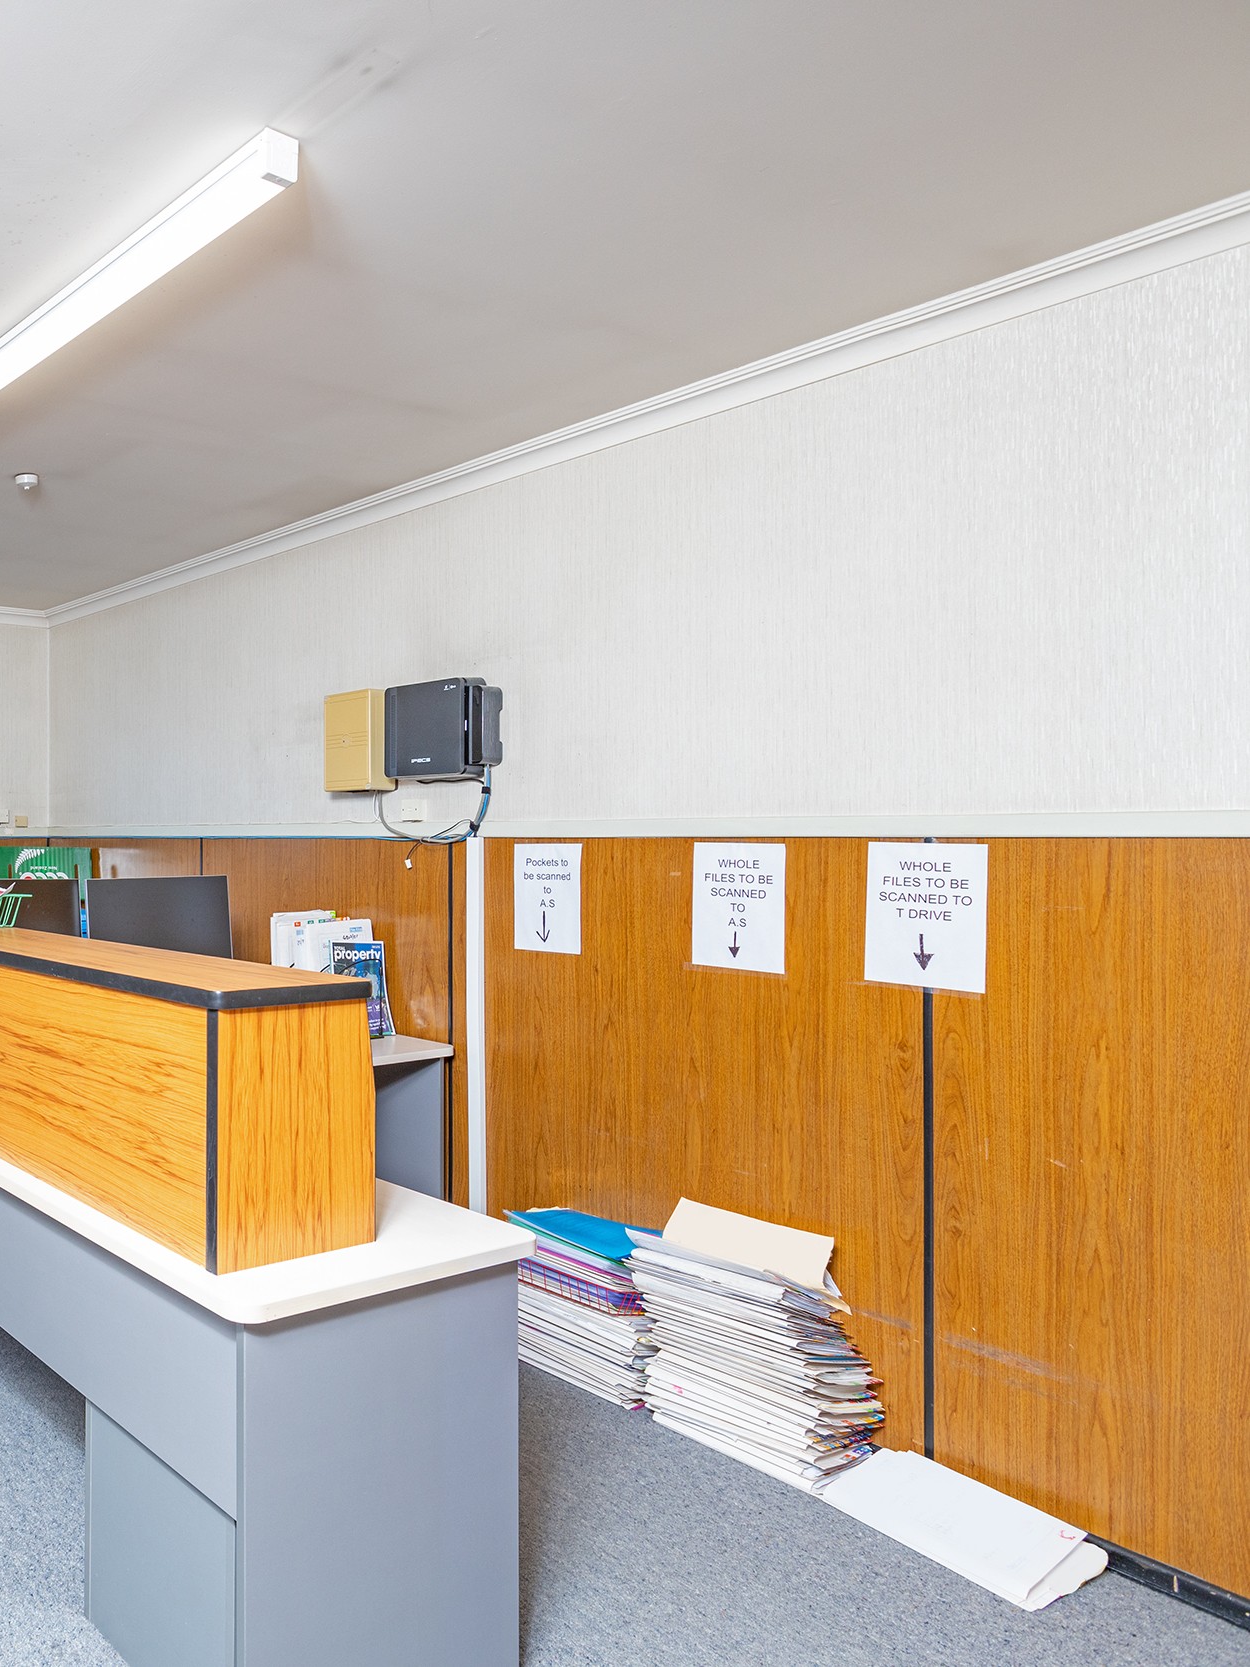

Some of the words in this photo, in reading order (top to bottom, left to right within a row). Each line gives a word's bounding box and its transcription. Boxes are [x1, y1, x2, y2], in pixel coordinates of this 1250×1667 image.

[525, 857, 559, 867] Pockets
[560, 859, 569, 867] to
[717, 858, 760, 869] WHOLE
[899, 861, 952, 873] WHOLE
[523, 872, 534, 880] be
[536, 872, 571, 881] scanned
[704, 873, 736, 883] FILES
[738, 874, 755, 884] TO
[758, 874, 773, 885] BE
[883, 876, 921, 888] FILES
[925, 877, 945, 889] TO
[950, 879, 969, 889] BE
[543, 886, 552, 894] to
[710, 887, 767, 899] SCANNED
[540, 899, 556, 908] A.S
[879, 891, 948, 905] SCANNED
[952, 895, 973, 906] TO
[730, 902, 746, 913] TO
[896, 908, 904, 918] T
[908, 909, 952, 921] DRIVE
[728, 917, 747, 928] A.S
[334, 949, 381, 962] property
